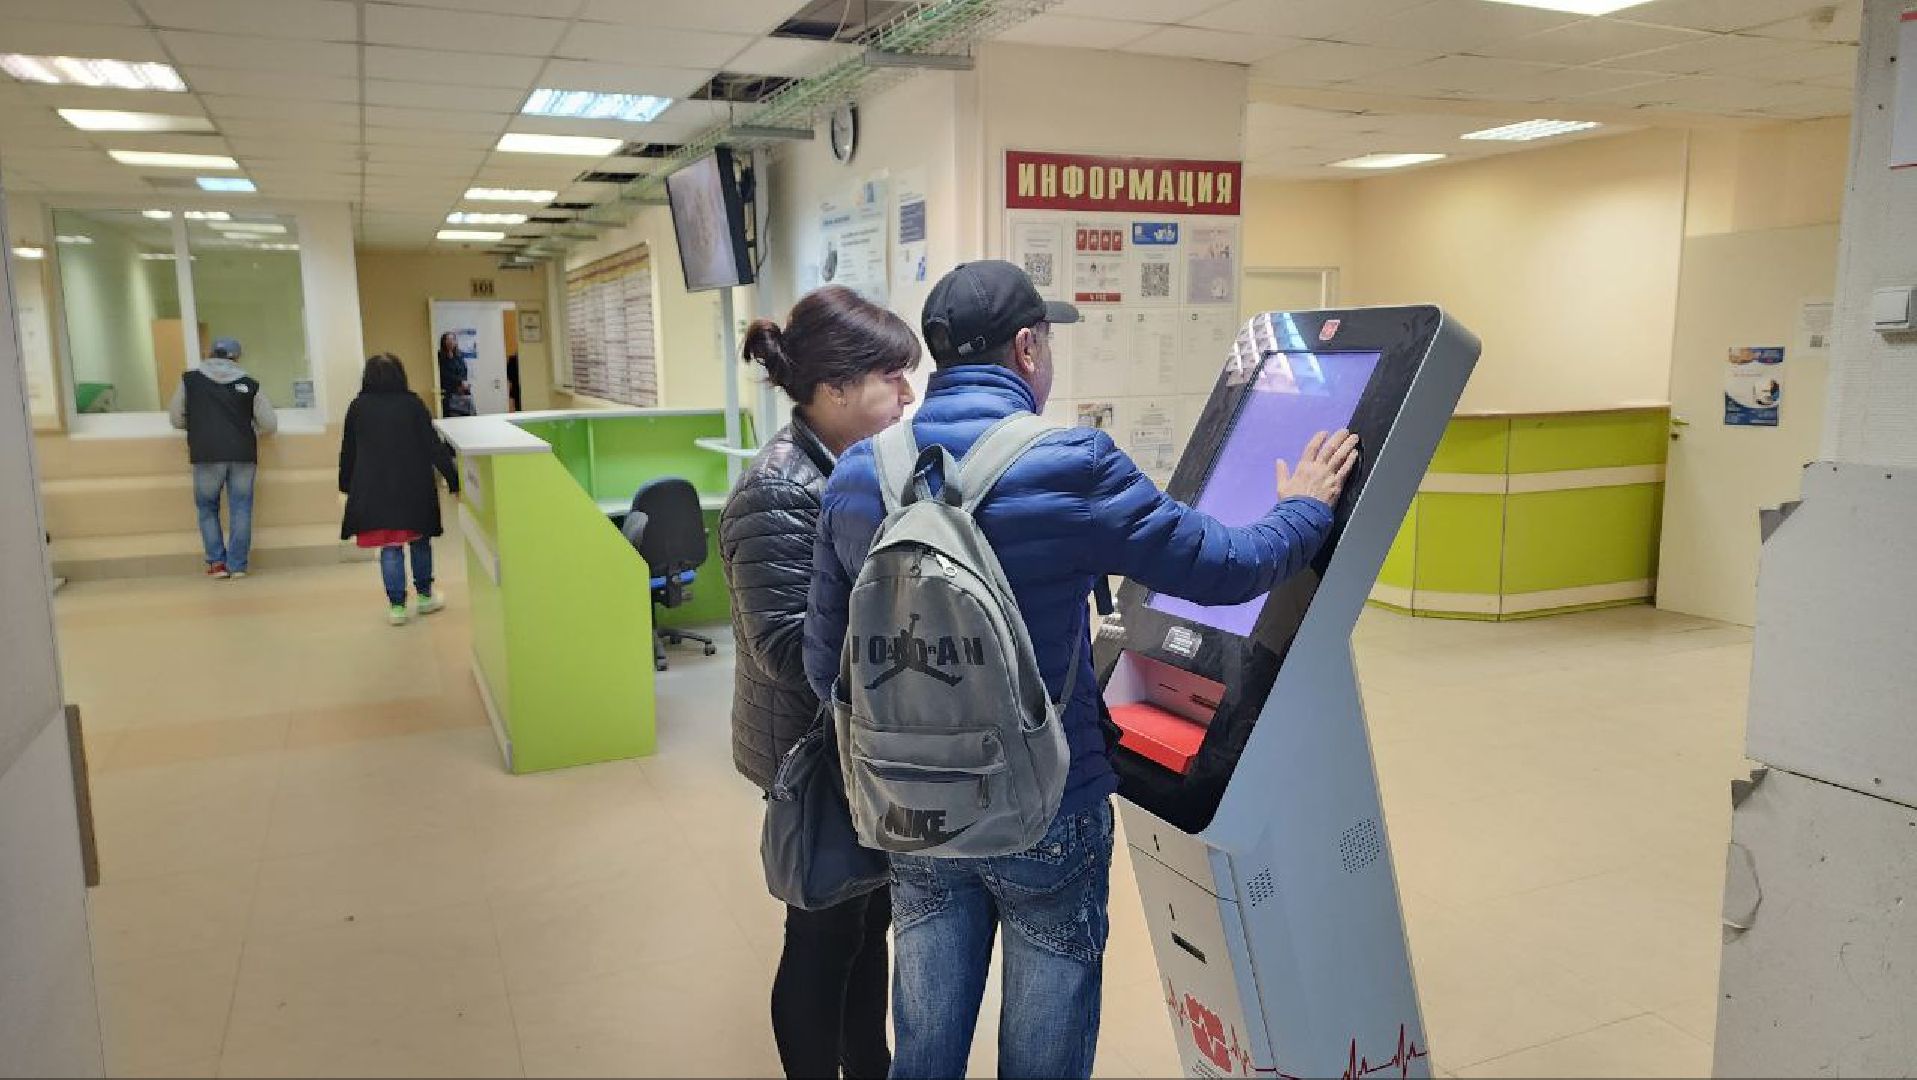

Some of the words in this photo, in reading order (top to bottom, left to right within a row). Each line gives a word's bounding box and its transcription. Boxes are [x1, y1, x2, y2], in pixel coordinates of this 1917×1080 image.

[1018, 163, 1232, 206] ИНФОРМАЦИЯ
[472, 281, 494, 296] 101
[885, 802, 947, 839] NIKE
